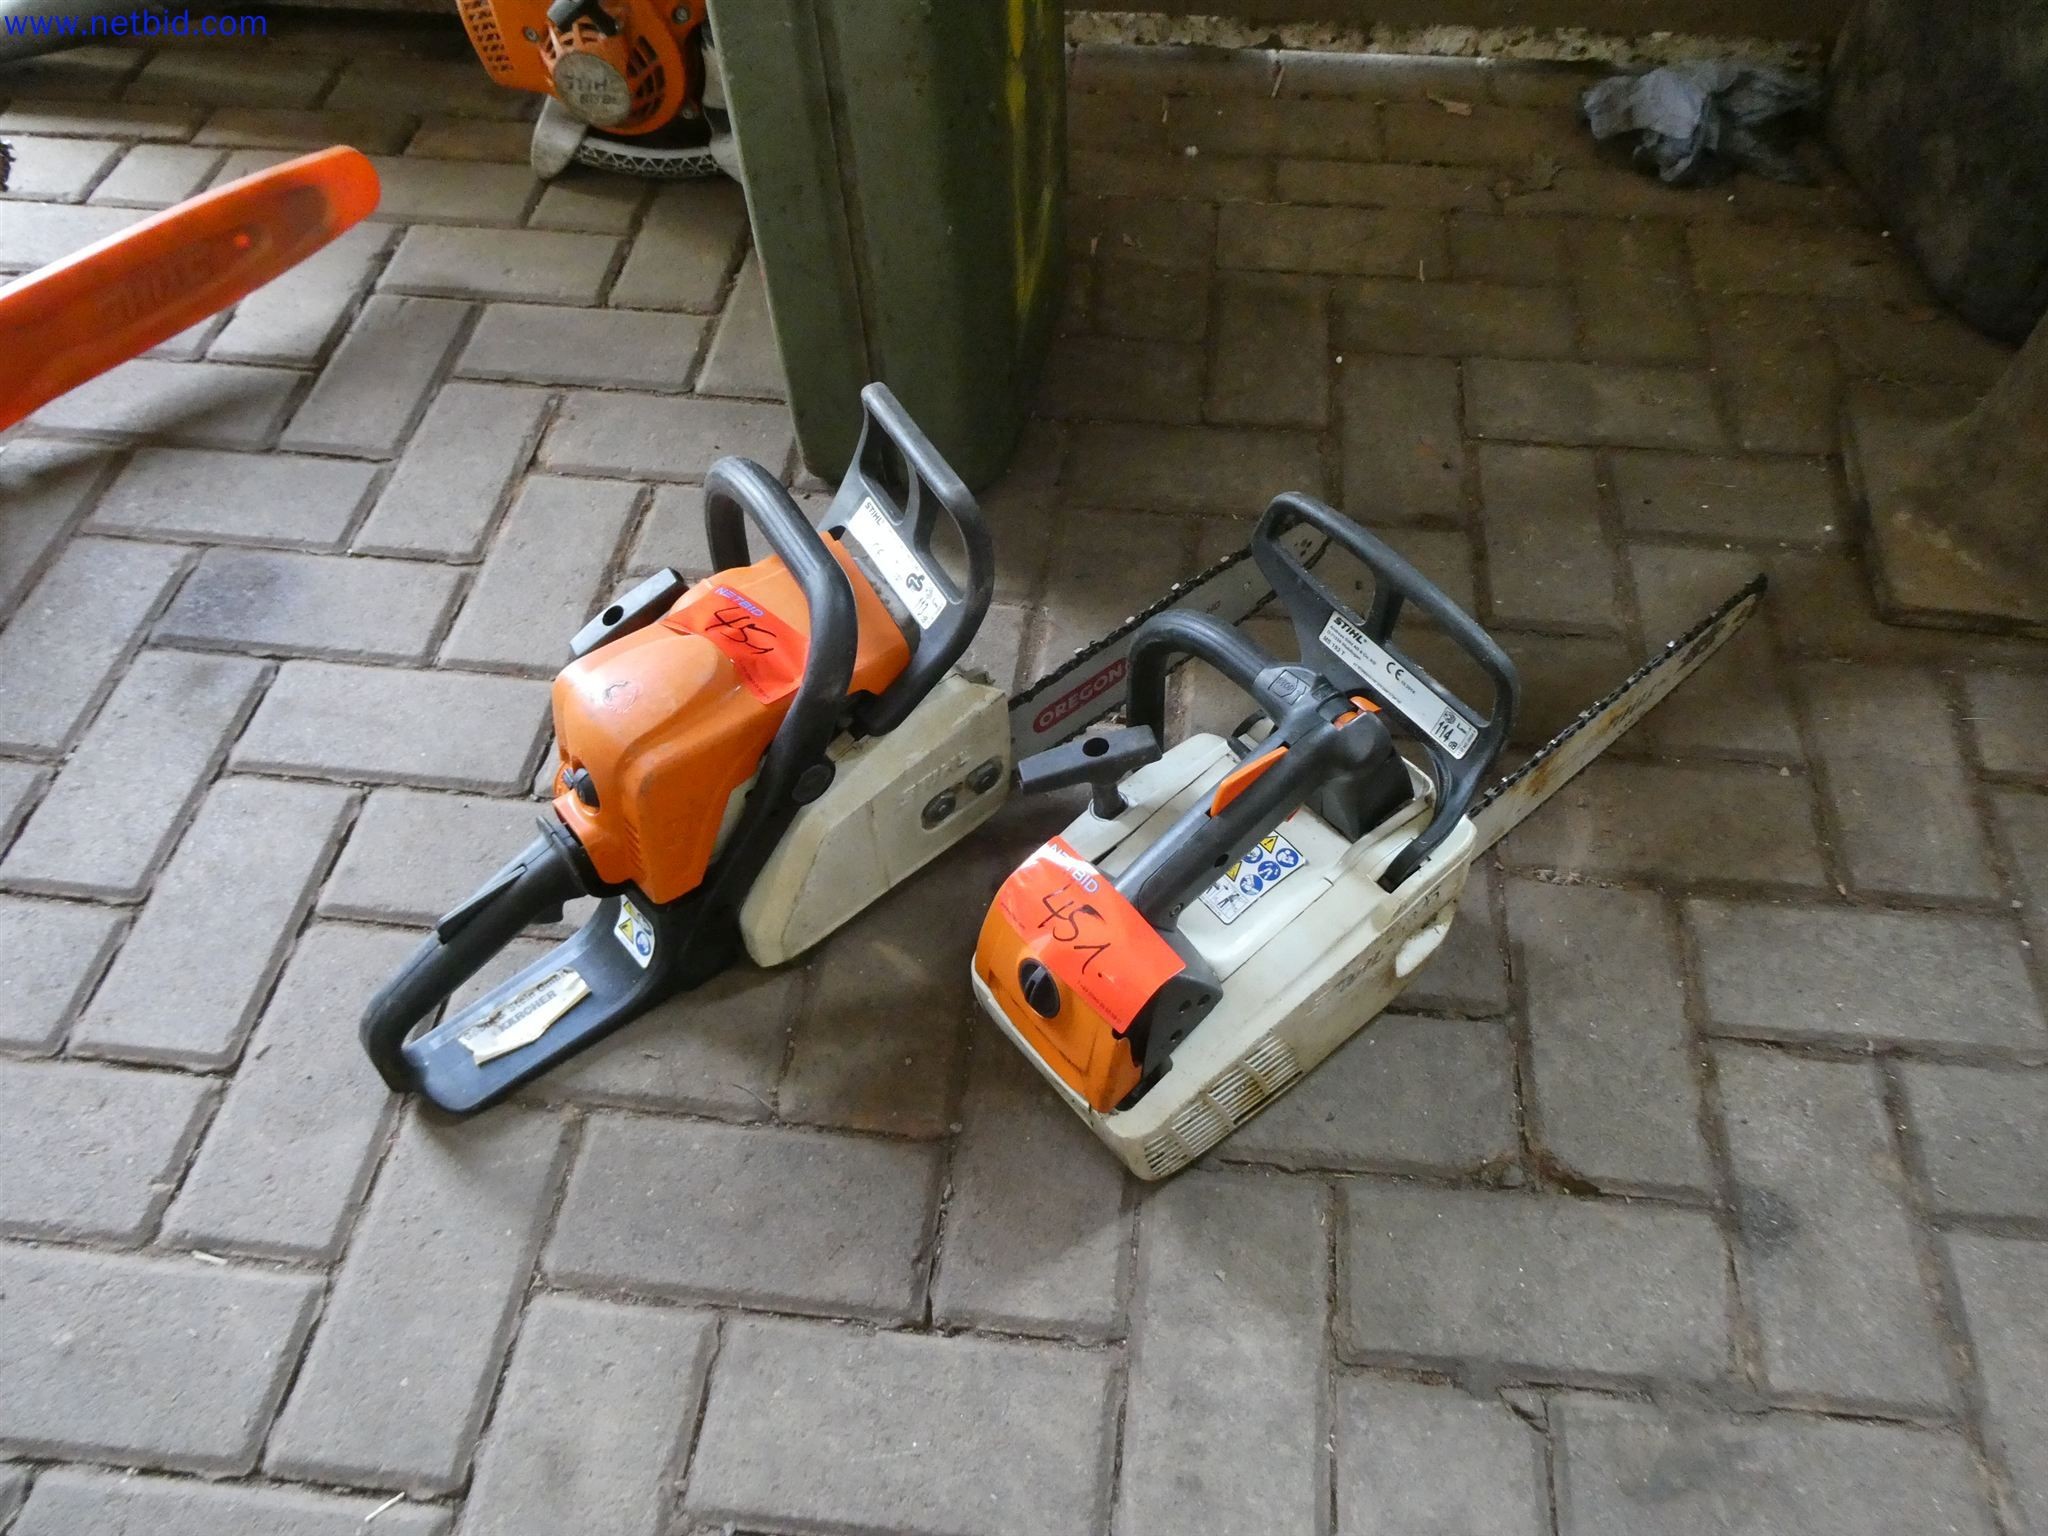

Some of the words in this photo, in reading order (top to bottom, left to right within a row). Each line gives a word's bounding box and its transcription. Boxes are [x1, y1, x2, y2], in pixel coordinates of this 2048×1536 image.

[864, 502, 882, 526] STIHL
[714, 586, 764, 617] NETBID
[705, 606, 777, 654] 451
[1333, 616, 1363, 645] STIHL
[1038, 662, 1122, 727] OREGON
[1435, 721, 1454, 743] 114
[1050, 843, 1099, 893] NEBID
